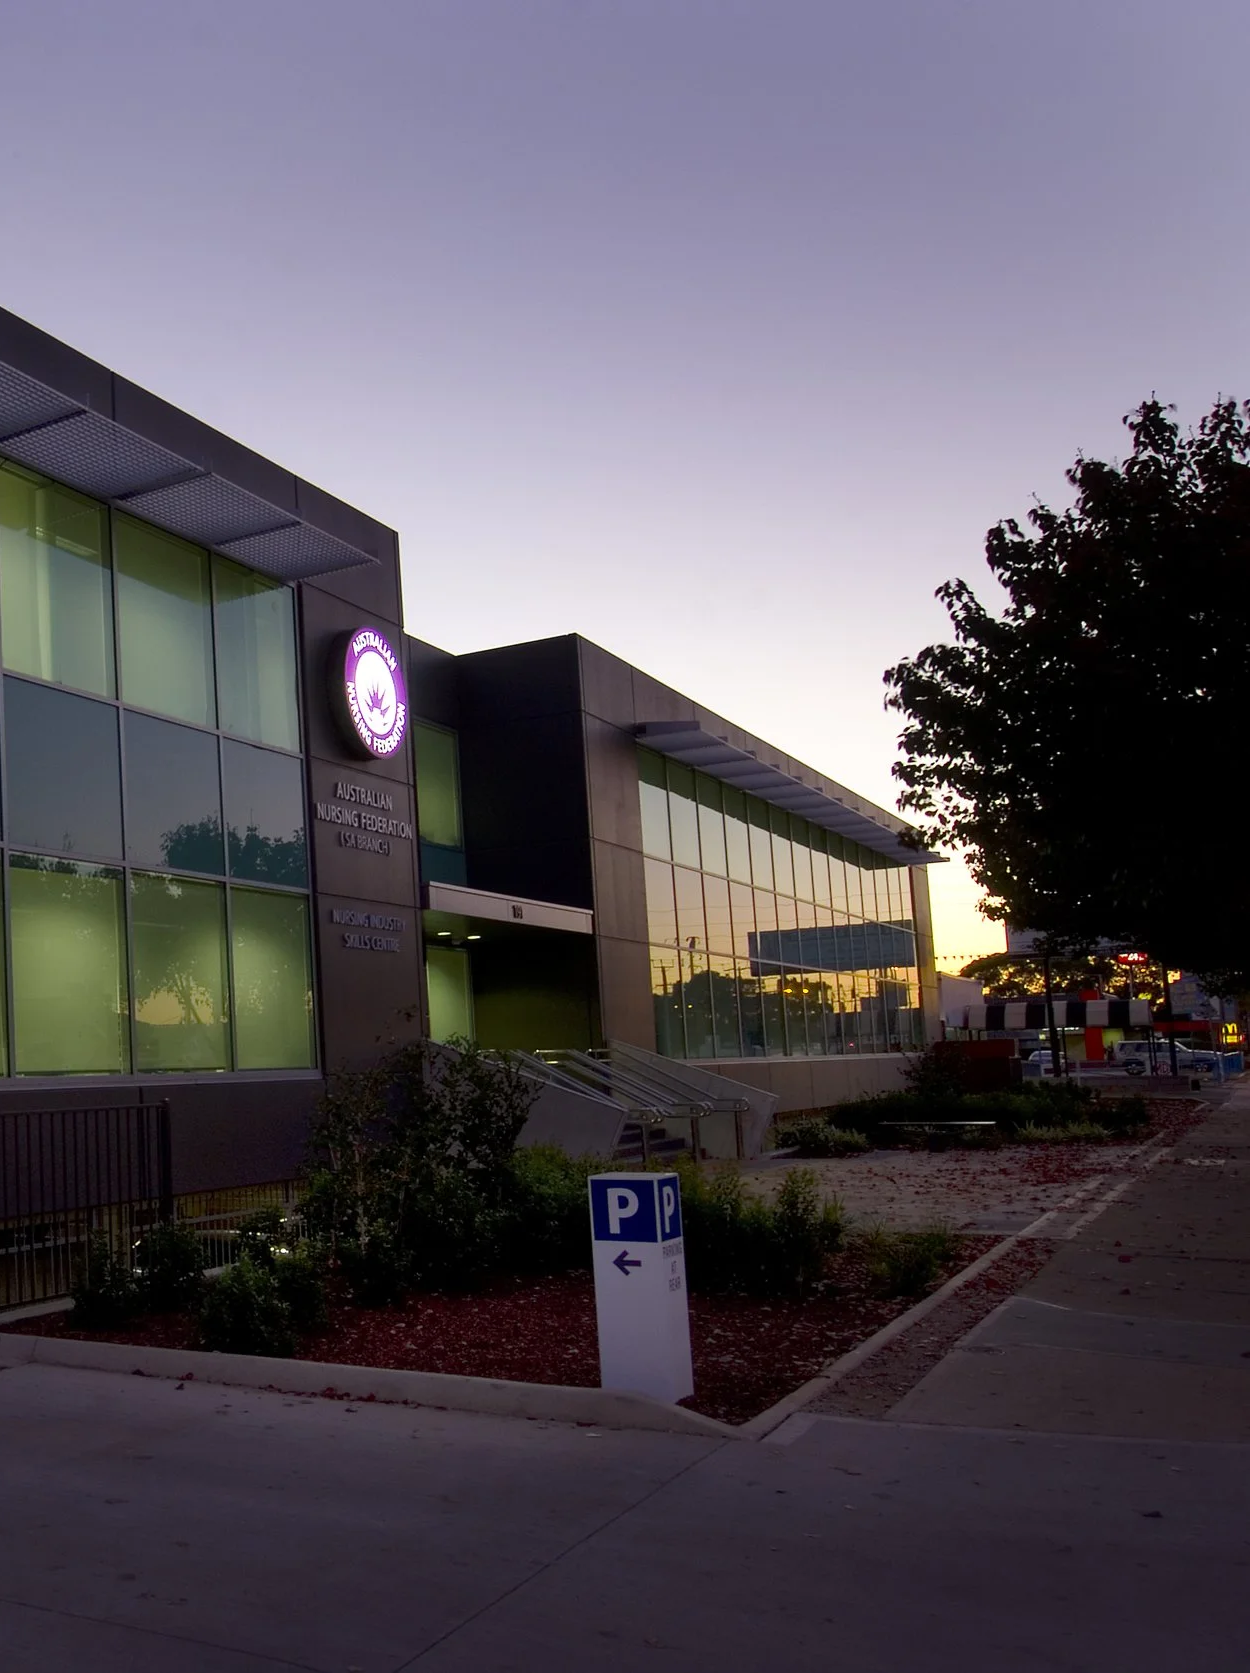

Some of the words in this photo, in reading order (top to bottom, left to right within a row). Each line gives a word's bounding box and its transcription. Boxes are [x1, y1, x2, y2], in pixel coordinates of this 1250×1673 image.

[352, 631, 398, 672] AUSTRALIAN
[347, 681, 372, 745] NURSING
[373, 702, 406, 754] FEDERATION
[336, 781, 393, 811] AUSTRALIAN
[317, 802, 359, 828] NURSING
[361, 812, 413, 839] FEDERATION
[333, 908, 369, 928] NURSING
[369, 914, 406, 932] INDUSTRY
[344, 932, 370, 950] SKILLS
[370, 936, 400, 953] CENTRE
[607, 1187, 639, 1234] P
[662, 1185, 675, 1233] P
